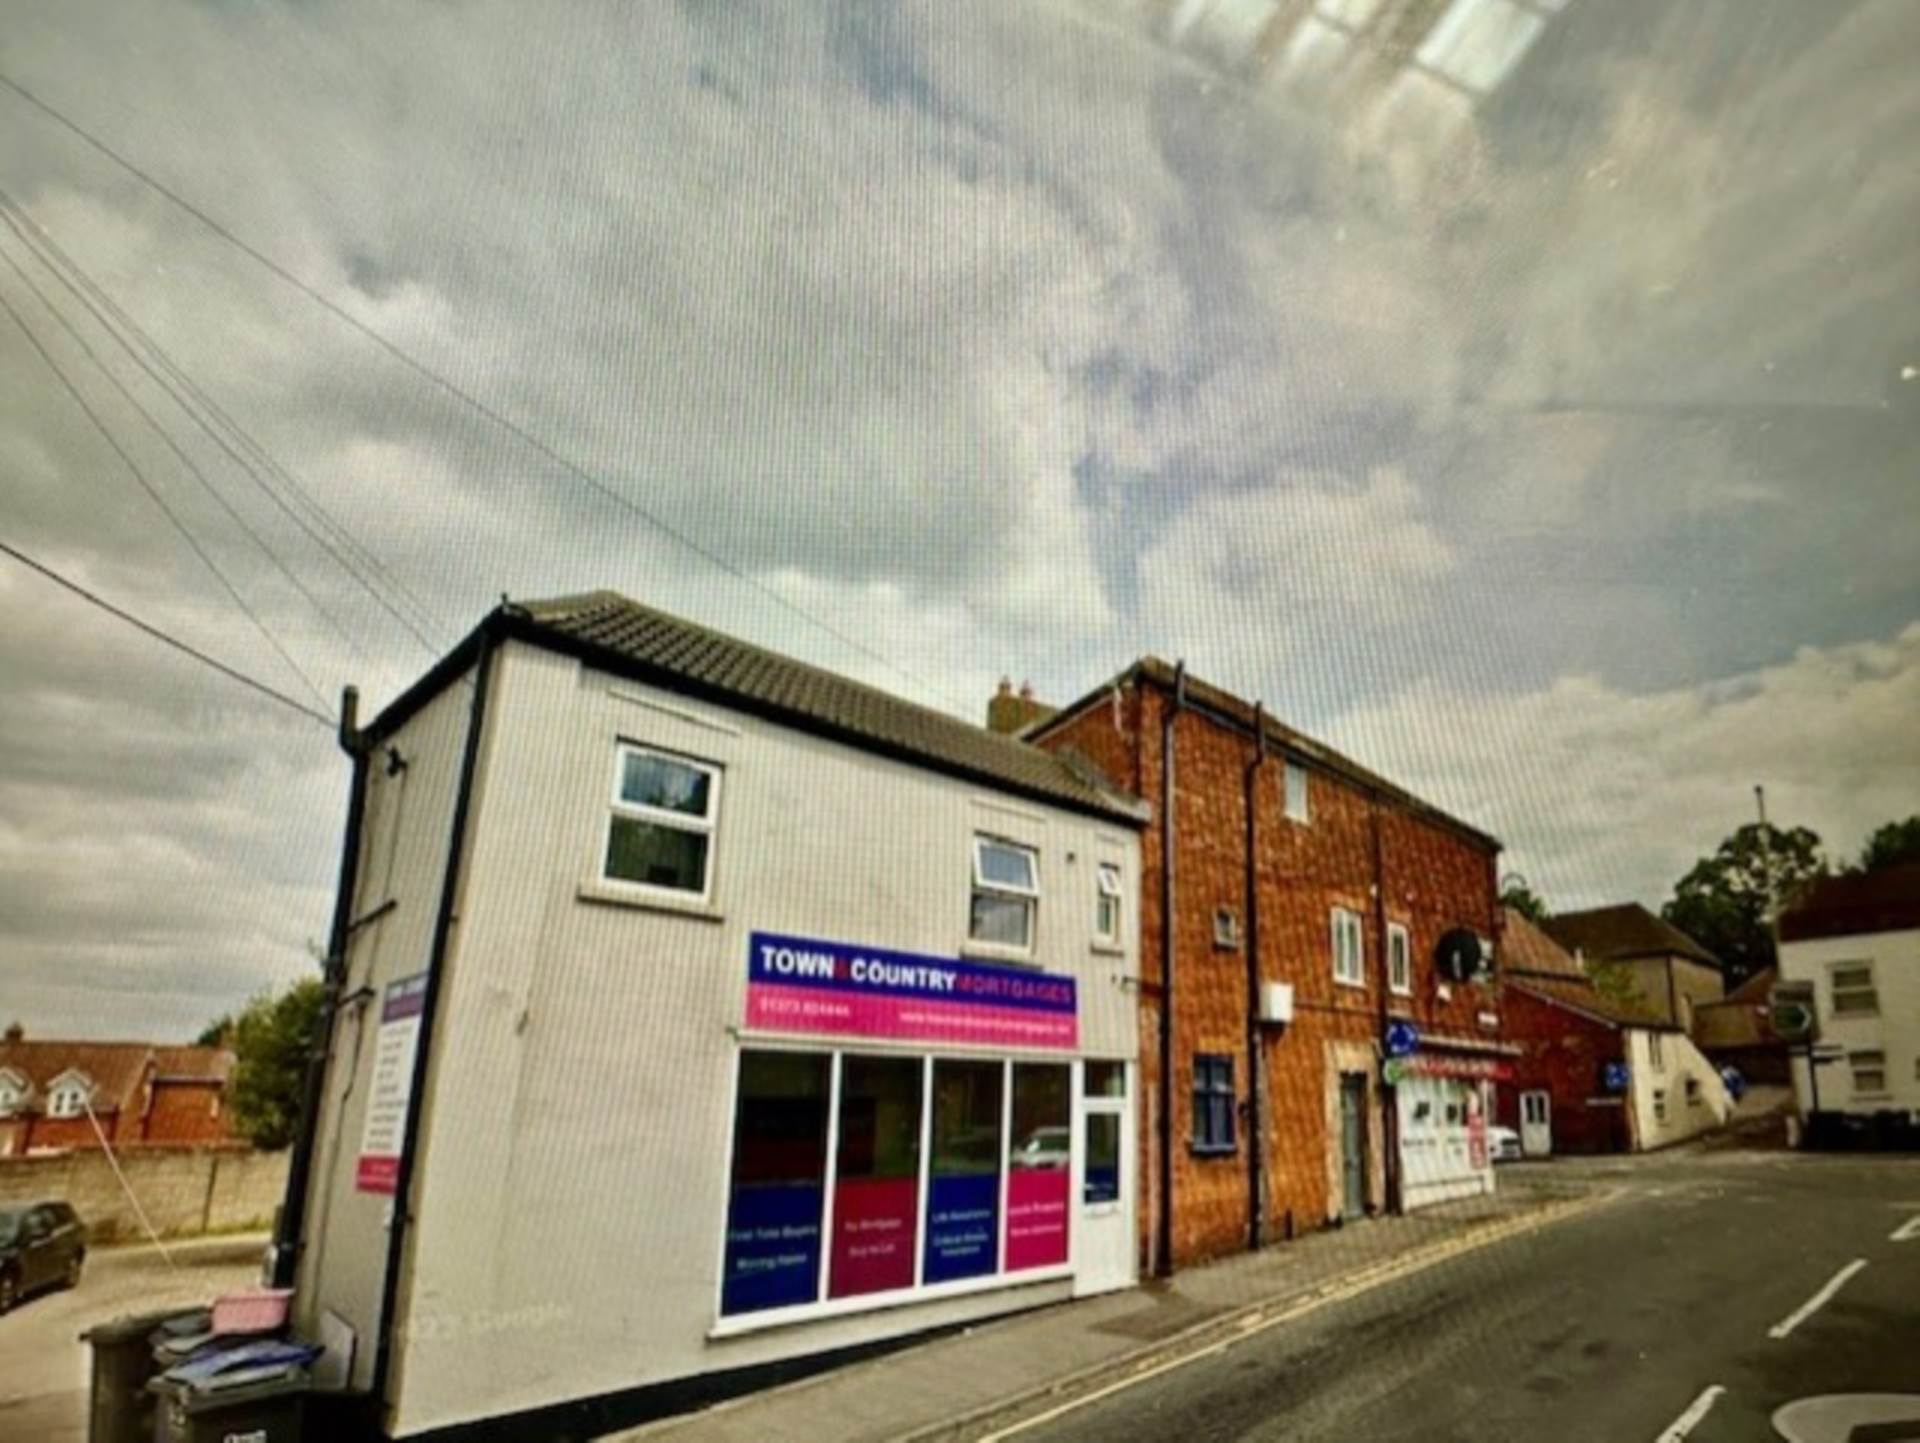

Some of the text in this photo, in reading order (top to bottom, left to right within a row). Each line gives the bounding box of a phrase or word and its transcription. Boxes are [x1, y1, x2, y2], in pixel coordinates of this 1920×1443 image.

[761, 945, 835, 979] TOWN
[851, 957, 957, 992] COUNTRY
[958, 975, 1071, 1004] MORTGAGES
